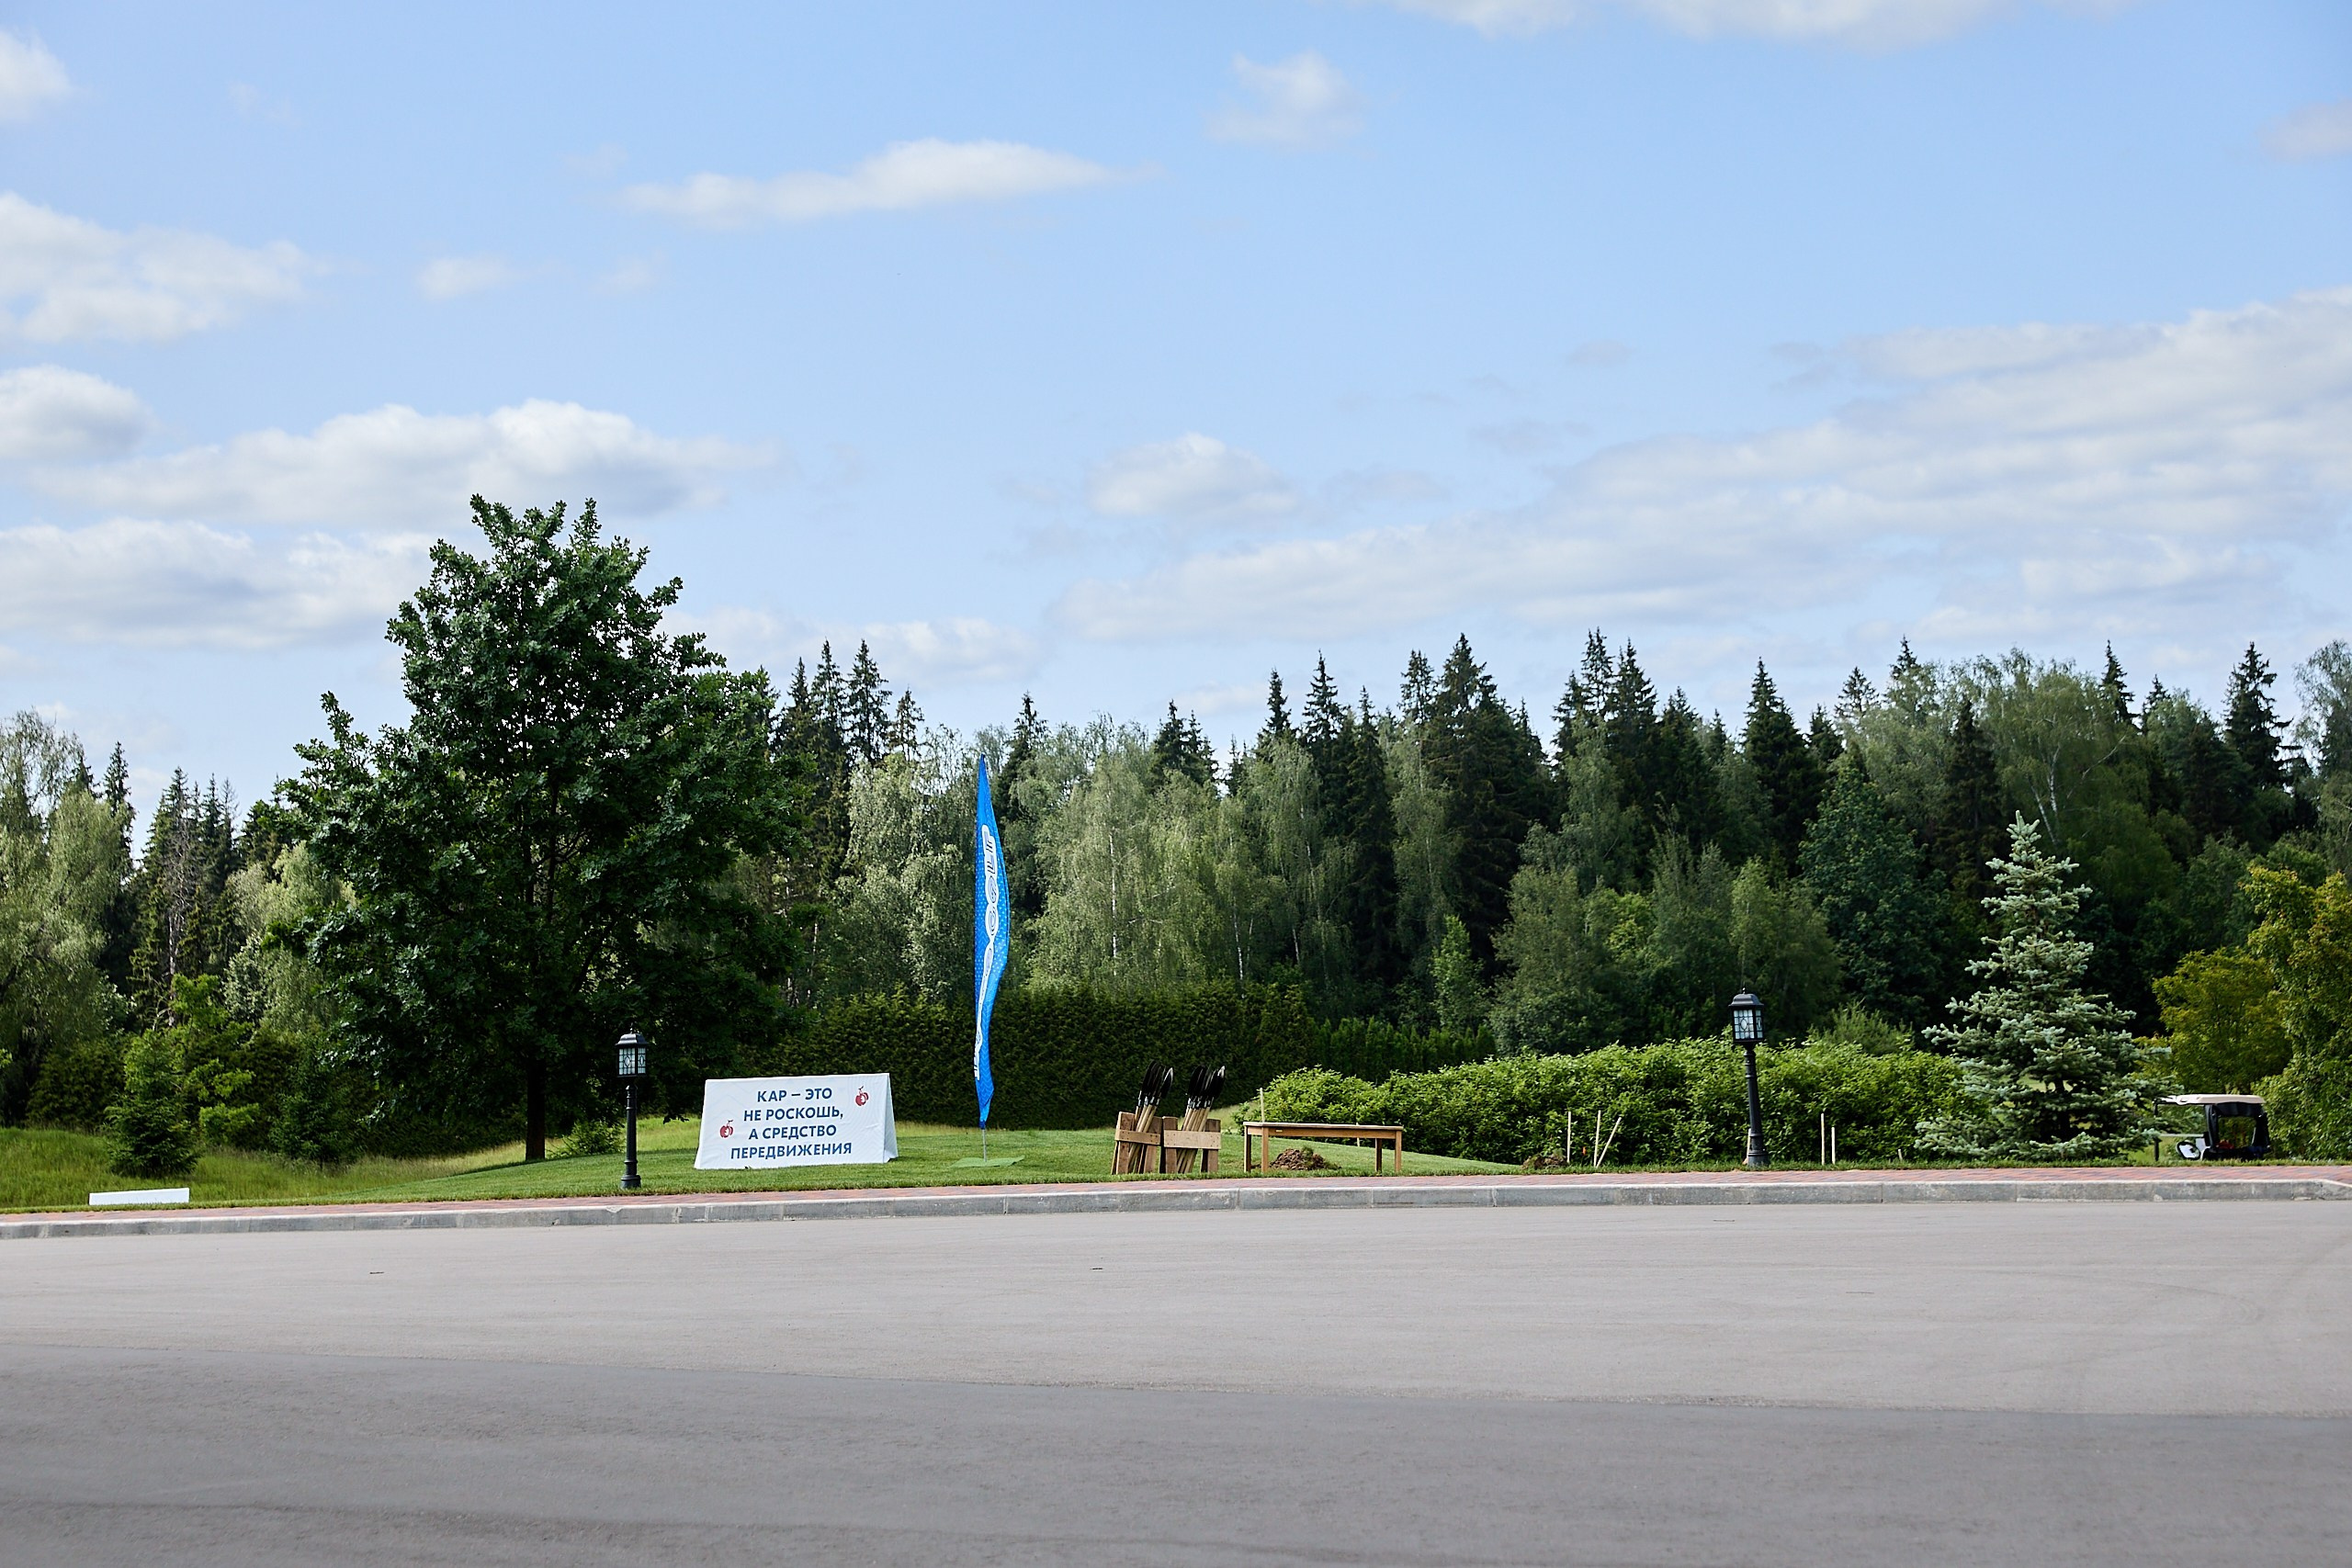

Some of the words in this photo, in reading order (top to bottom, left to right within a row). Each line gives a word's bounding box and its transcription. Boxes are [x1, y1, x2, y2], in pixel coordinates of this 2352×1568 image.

[757, 1089, 787, 1102] КАР
[805, 1088, 832, 1100] ЭТО
[743, 1110, 762, 1122] НЕ
[765, 1106, 843, 1121] РОСКОШЬ,
[748, 1128, 759, 1140] А
[762, 1124, 837, 1140] СРЕДСТВО
[730, 1142, 852, 1160] ПЕРЕДВИЖЕНИЯ
